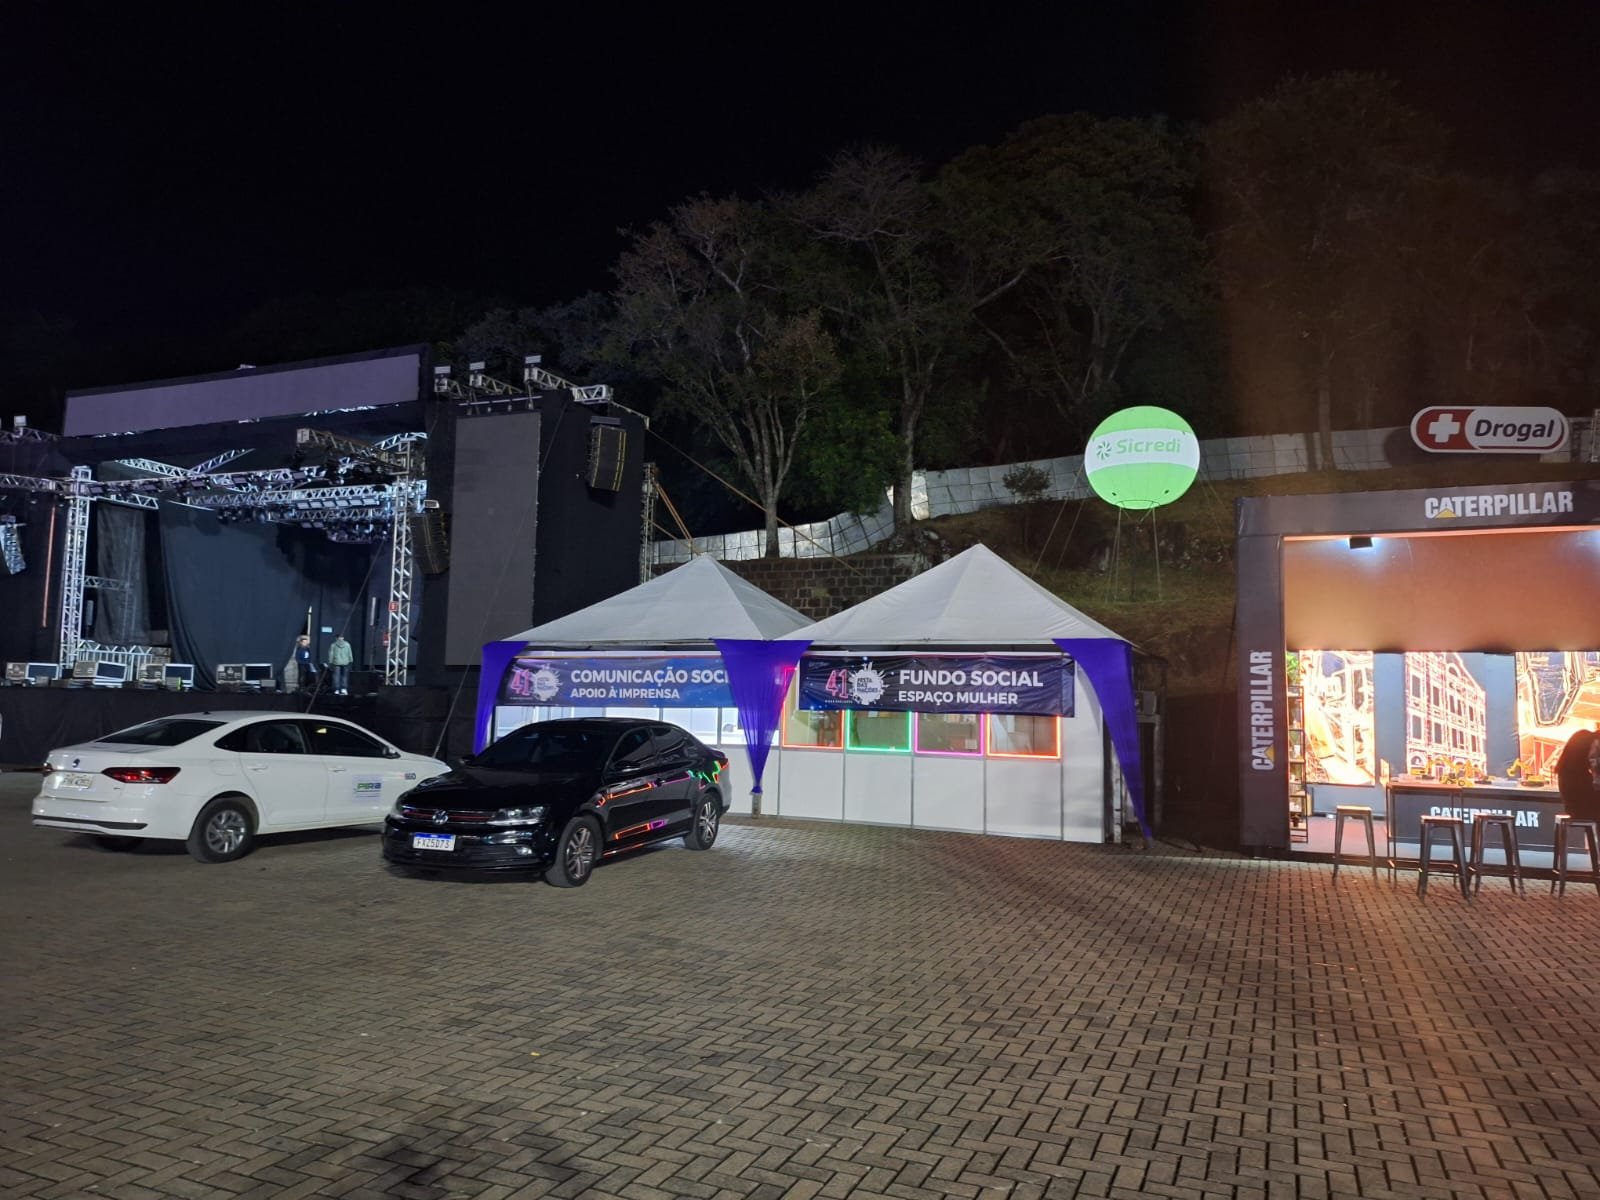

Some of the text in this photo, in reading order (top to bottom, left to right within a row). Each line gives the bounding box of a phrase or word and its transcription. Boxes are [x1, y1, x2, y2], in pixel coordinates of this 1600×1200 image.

[1475, 419, 1554, 442] Drogal
[1116, 438, 1181, 454] Sicredi
[1424, 491, 1574, 518] CATERPILLAR
[571, 667, 688, 687] COMUNICAÇÃO
[826, 669, 848, 699] 41
[900, 670, 1043, 687] FUNDO SOCIAL
[570, 686, 680, 699] APOIO À IMPRENSA
[898, 691, 1018, 706] ESPAÇO MULHER
[1250, 651, 1274, 770] CATERPILLAR
